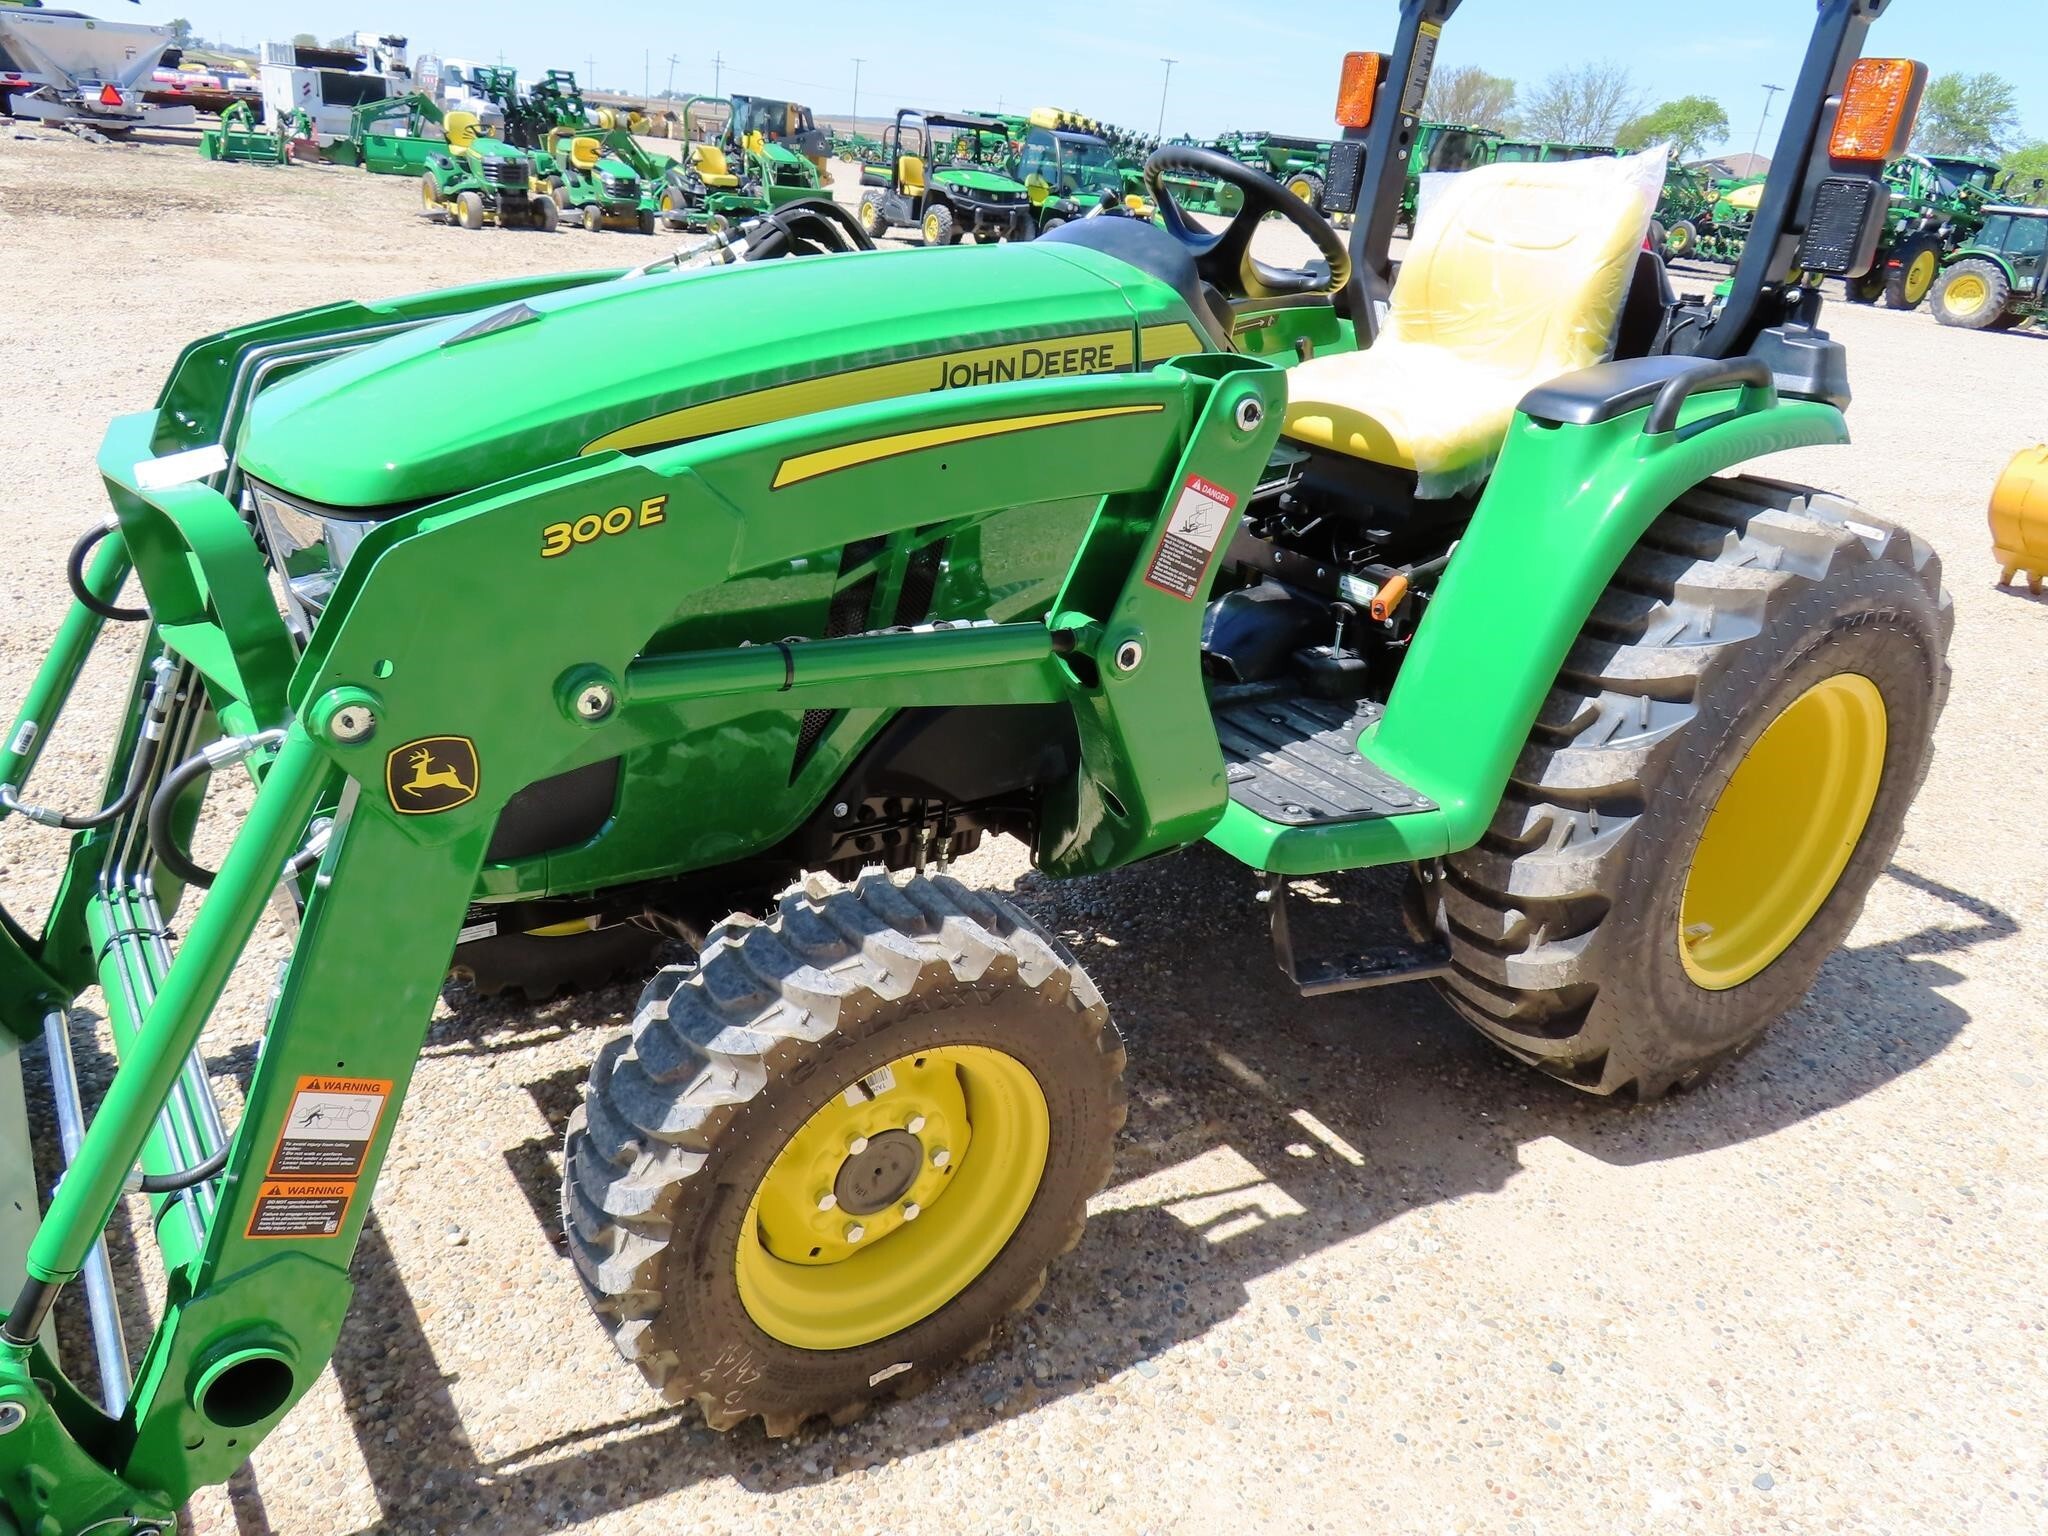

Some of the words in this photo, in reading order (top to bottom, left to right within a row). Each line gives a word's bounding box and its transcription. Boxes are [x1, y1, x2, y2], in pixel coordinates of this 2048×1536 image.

[929, 357, 1016, 392] JOHN
[1021, 344, 1114, 379] DEERE
[1201, 484, 1230, 504] DANGER
[324, 1083, 380, 1092] WARNING
[288, 1186, 344, 1195] WARNING
